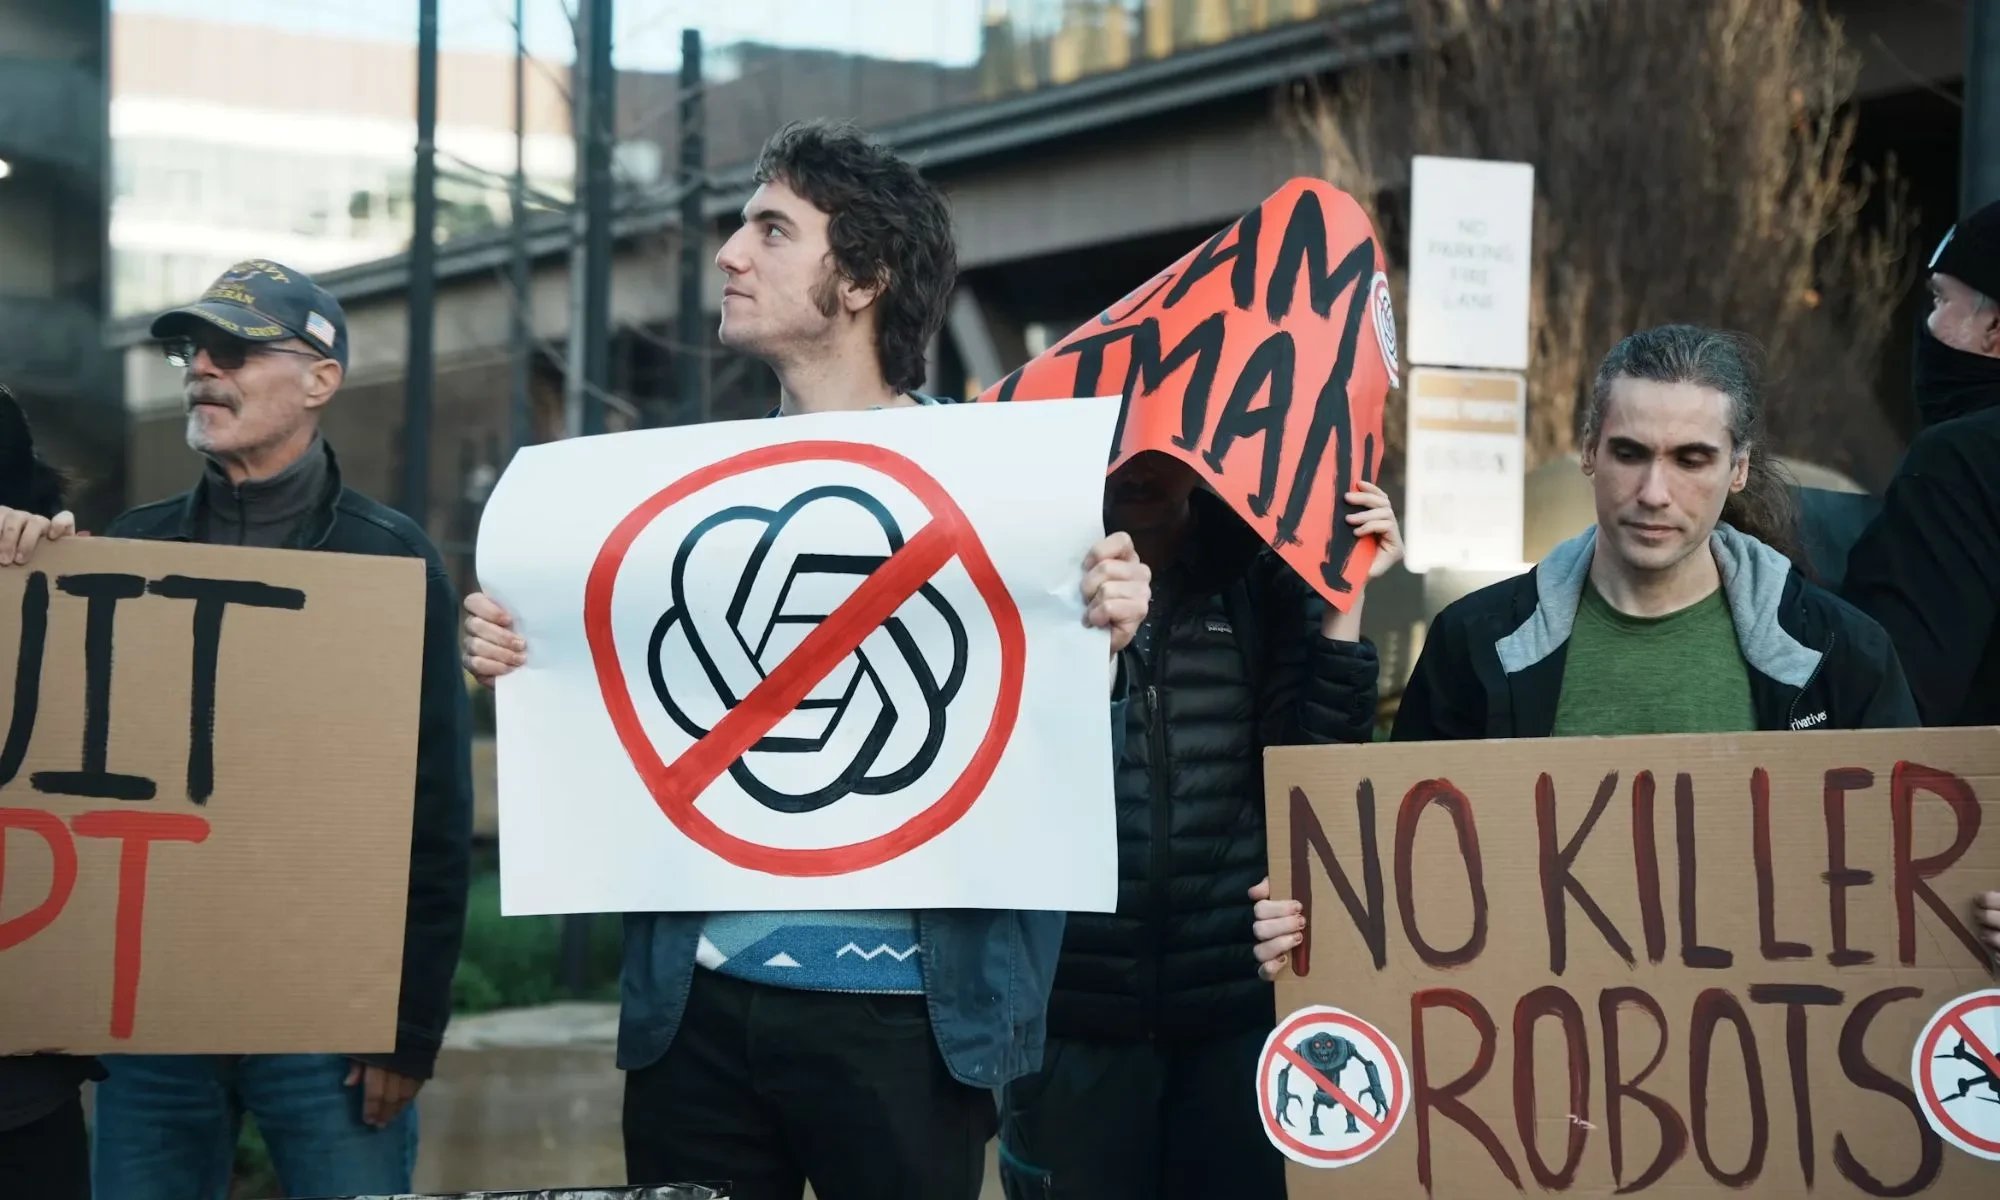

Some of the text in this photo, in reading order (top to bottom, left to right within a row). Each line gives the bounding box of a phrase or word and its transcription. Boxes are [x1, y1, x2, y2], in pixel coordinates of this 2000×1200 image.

[965, 311, 1375, 592] TMAN
[1289, 760, 1997, 977] NO KILLER
[1411, 984, 1943, 1199] ROBOTS
